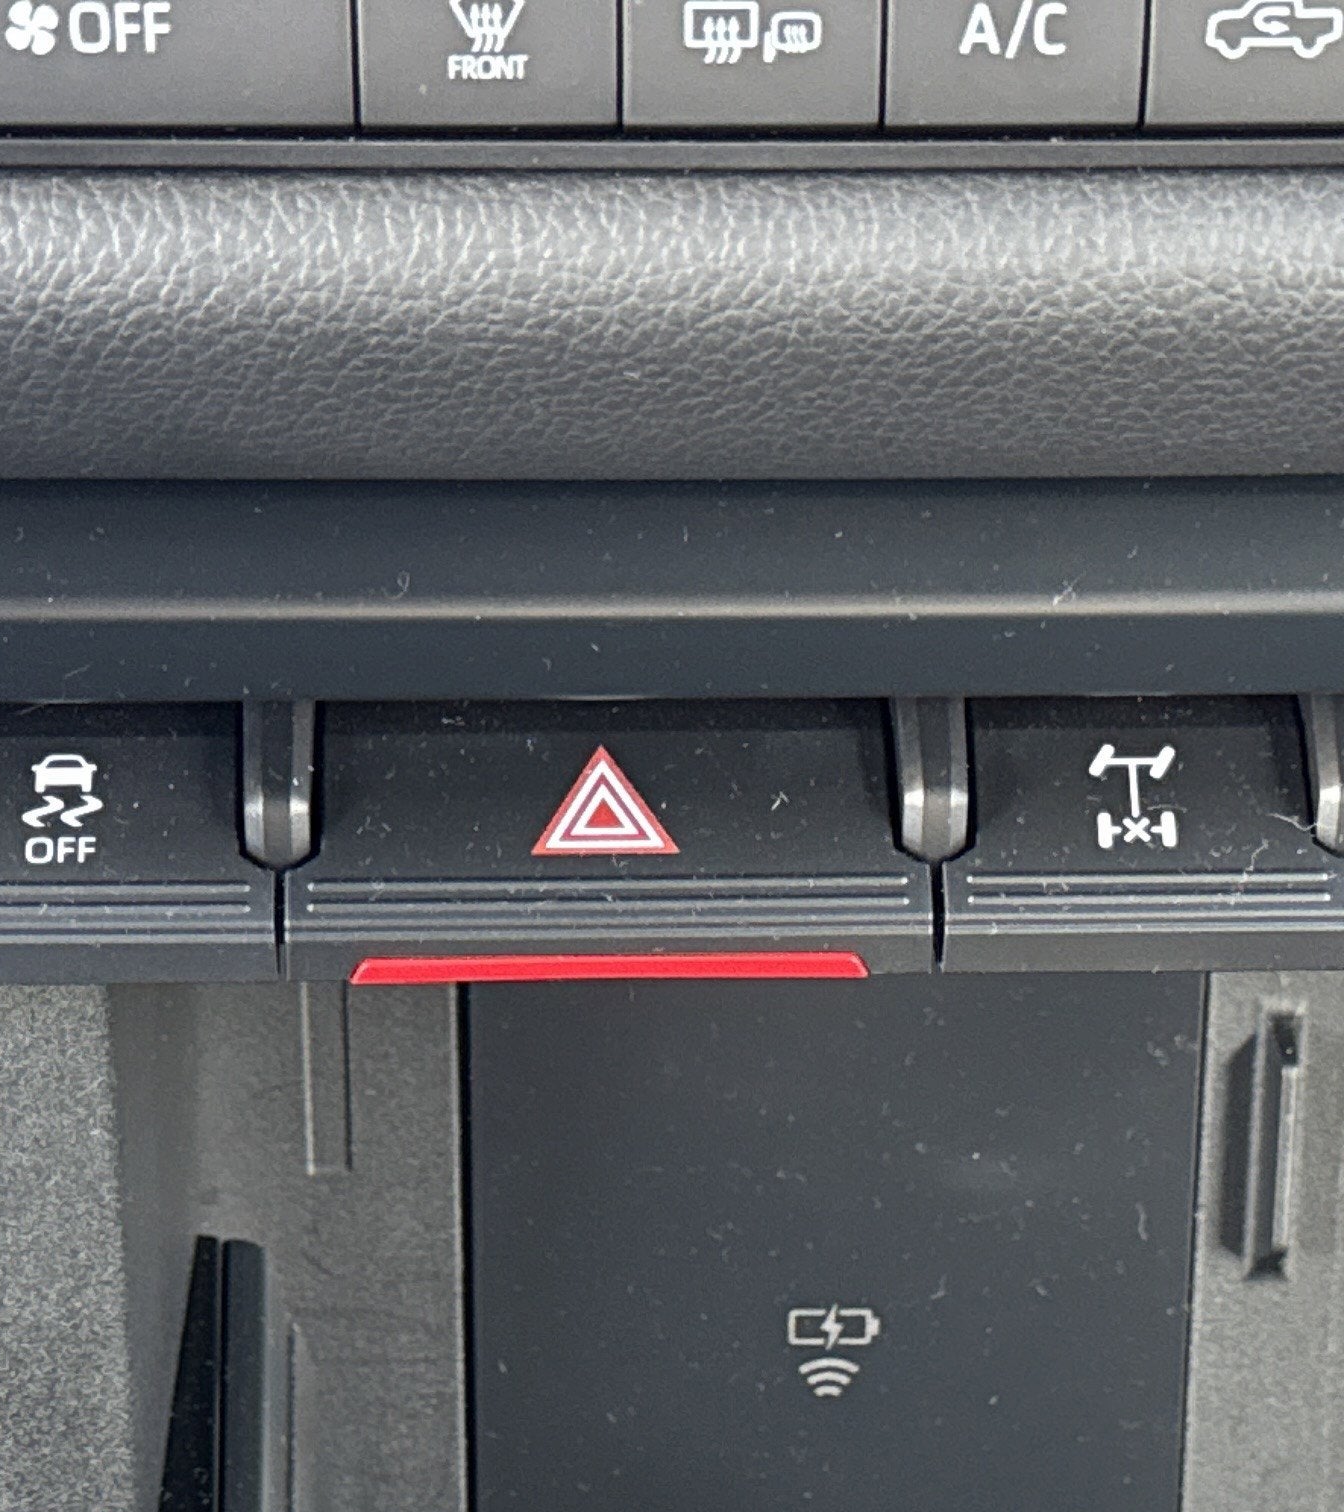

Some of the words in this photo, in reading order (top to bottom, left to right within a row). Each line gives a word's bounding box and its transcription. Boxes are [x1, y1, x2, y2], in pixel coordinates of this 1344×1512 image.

[69, 1, 171, 53] OFF
[959, 0, 1067, 59] A/C
[447, 54, 529, 80] FRONT
[24, 836, 96, 864] OFF
